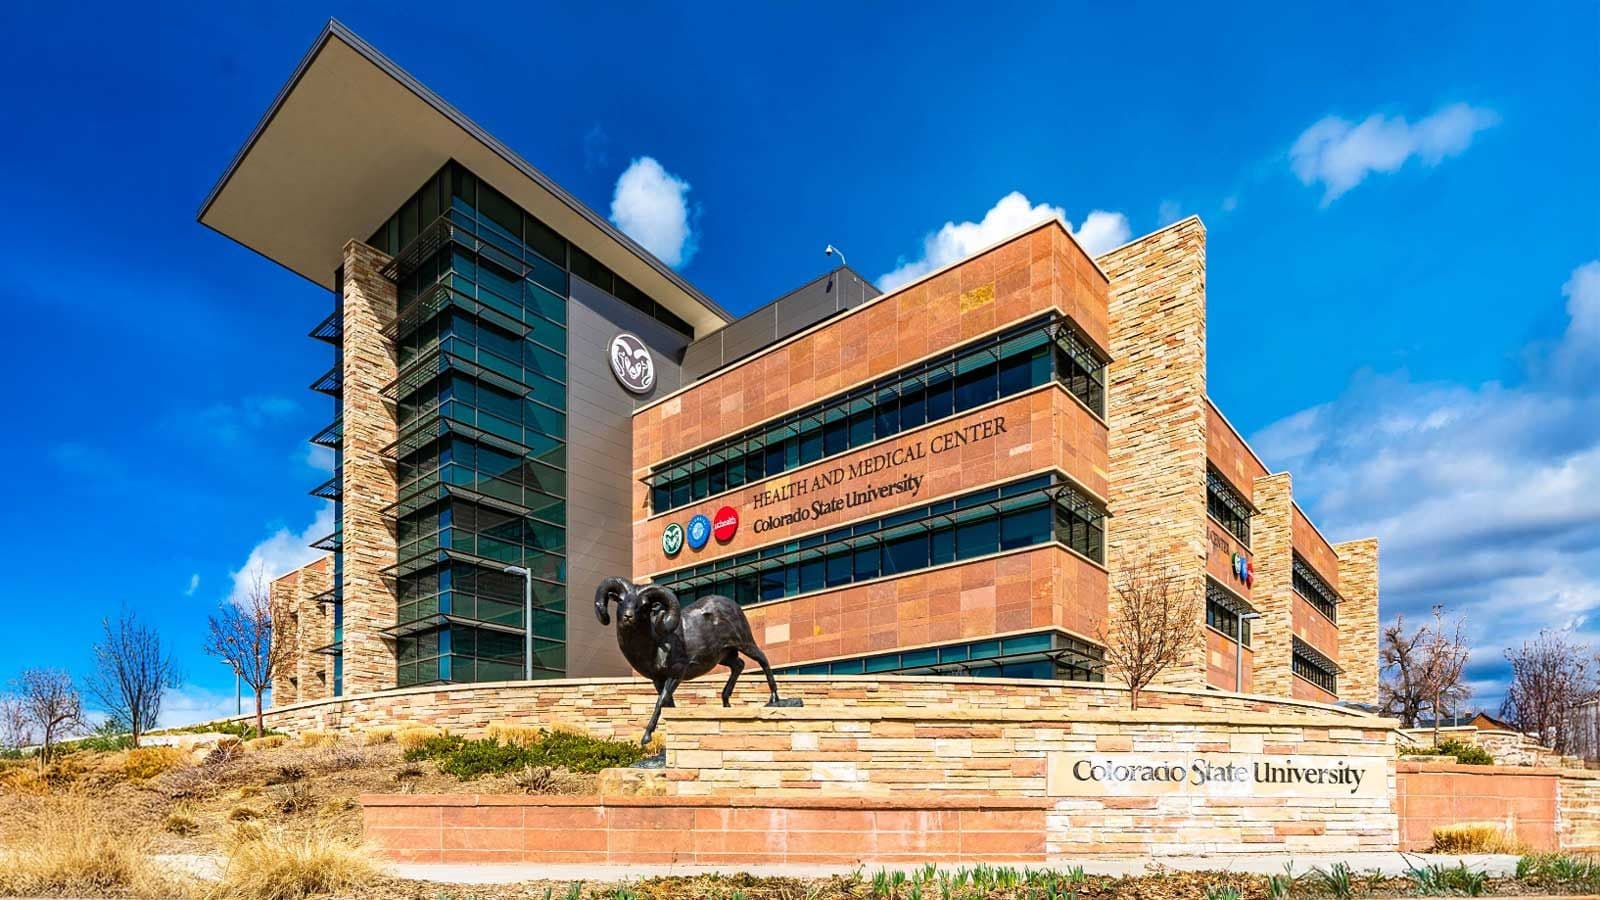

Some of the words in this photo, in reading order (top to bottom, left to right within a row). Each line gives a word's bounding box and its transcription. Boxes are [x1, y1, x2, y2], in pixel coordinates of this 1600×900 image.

[753, 478, 808, 509] HEALTH
[811, 468, 845, 492] AND
[848, 442, 926, 478] MEDICAL
[930, 416, 1007, 454] CENTER
[753, 508, 810, 534] Colorado
[810, 497, 844, 520] State
[845, 472, 924, 507] University
[1073, 760, 1187, 783] Colorado
[1190, 758, 1249, 785] State
[1253, 760, 1366, 794] University
